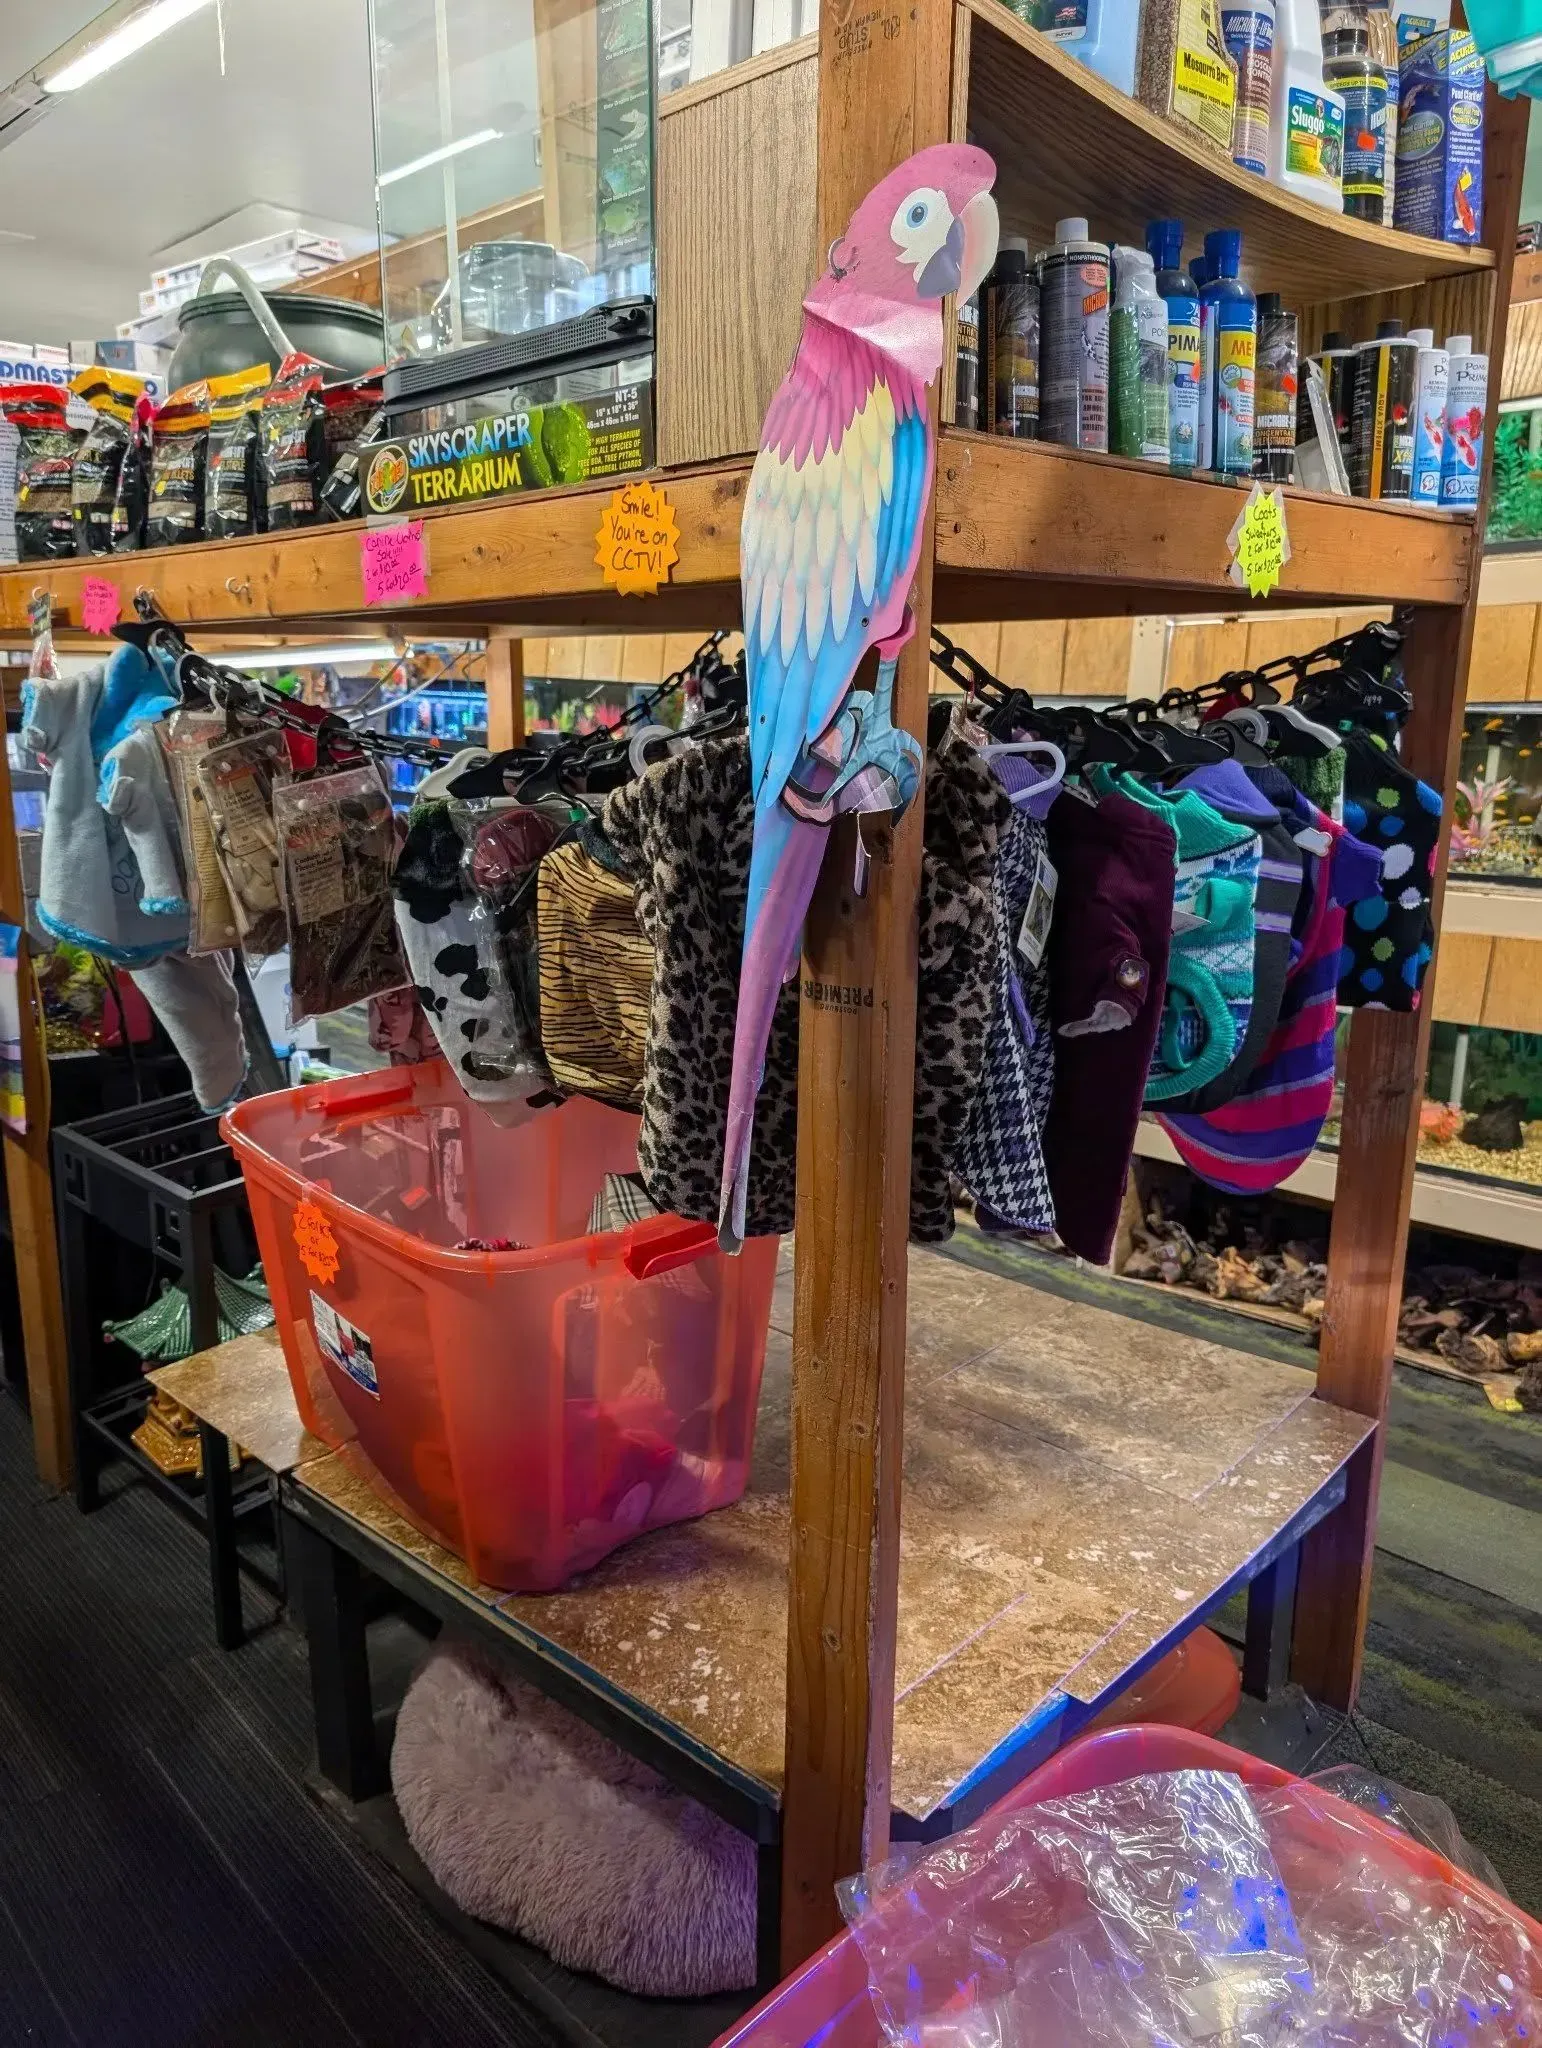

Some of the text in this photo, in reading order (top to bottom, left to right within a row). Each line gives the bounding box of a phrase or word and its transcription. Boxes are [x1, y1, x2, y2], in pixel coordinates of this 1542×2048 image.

[839, 26, 868, 49] STUD
[1291, 104, 1325, 135] Sluggo
[615, 388, 638, 403] NT-5
[1378, 394, 1386, 420] AQUA
[408, 413, 532, 469] SKYSCRAPER
[610, 440, 632, 452] SPECIES
[1374, 419, 1384, 451] XTREME
[411, 453, 522, 504] TERRARIUM
[621, 490, 660, 522] Smile!
[611, 515, 668, 547] You're on
[612, 546, 662, 574] CCTV!
[1247, 545, 1252, 557] 2
[1246, 563, 1251, 577] 5
[377, 580, 384, 596] 5
[804, 980, 874, 1008] PREMIER
